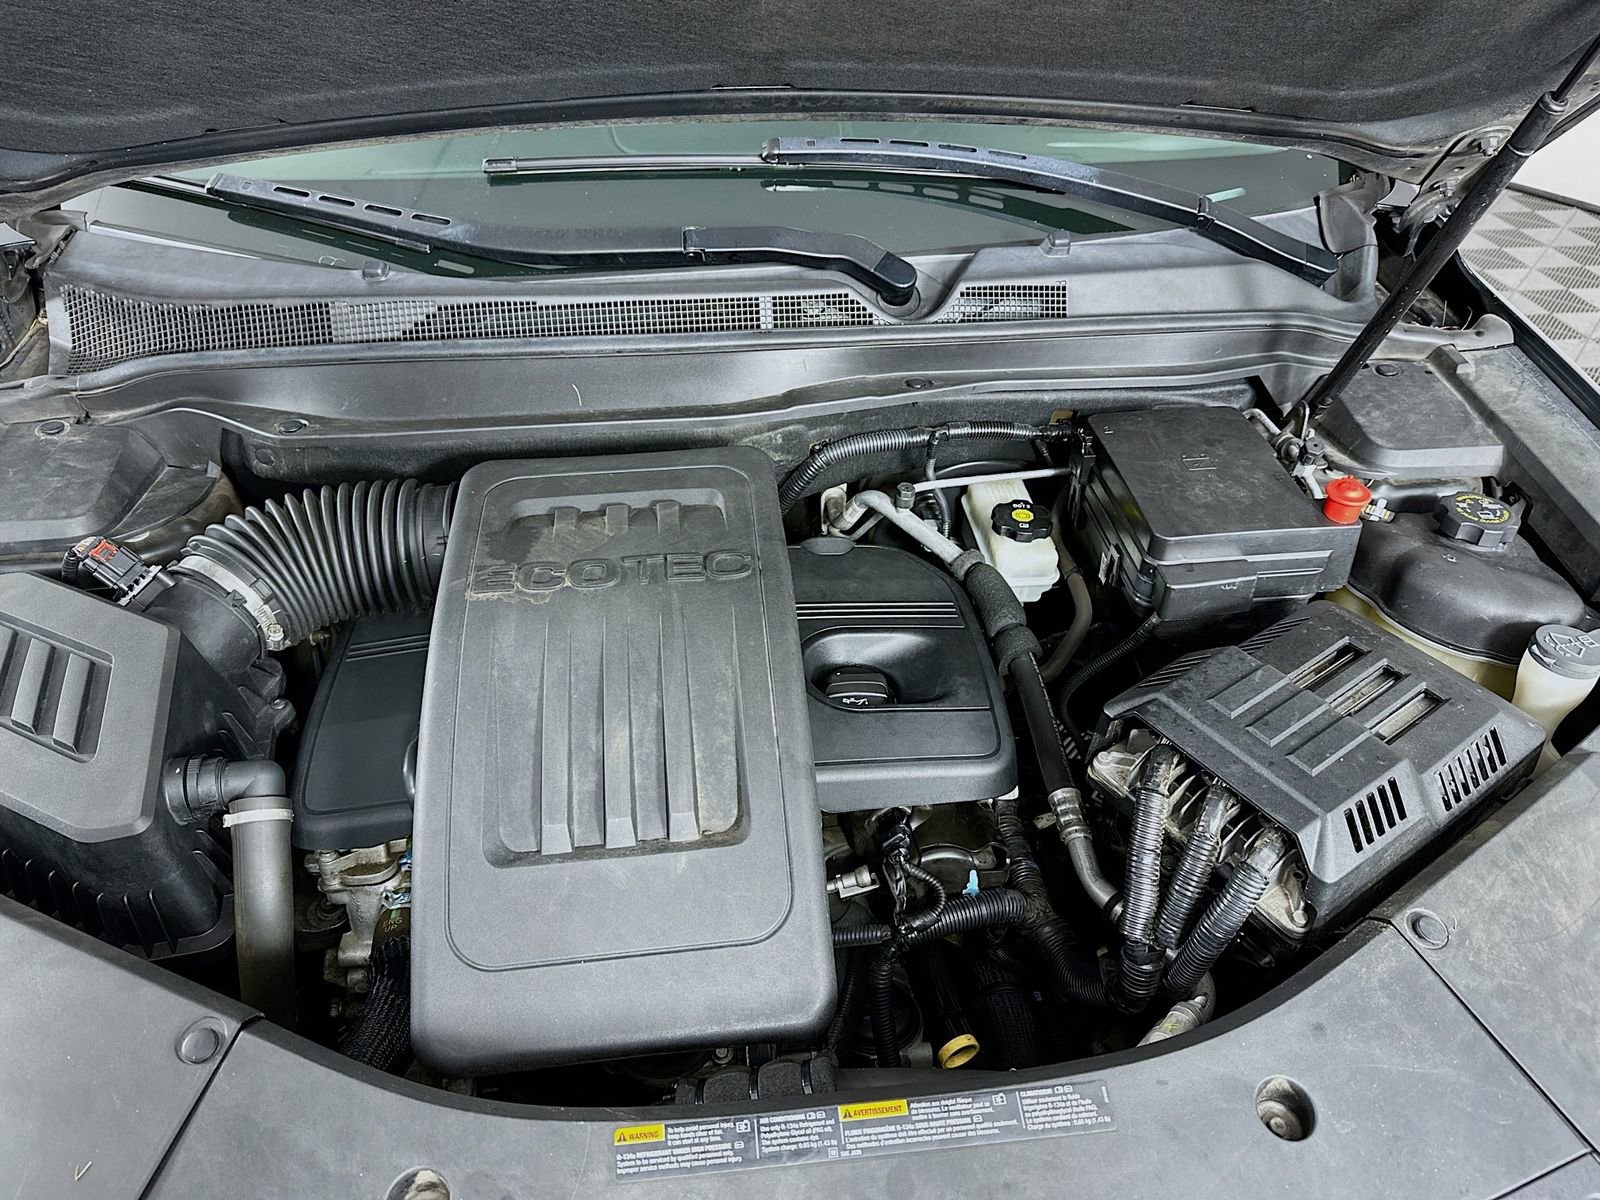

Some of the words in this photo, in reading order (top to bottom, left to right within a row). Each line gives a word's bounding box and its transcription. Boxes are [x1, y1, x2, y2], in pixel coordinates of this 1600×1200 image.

[472, 550, 752, 594] ECOTEC
[383, 918, 402, 928] ENG
[384, 924, 398, 932] UP
[854, 1106, 902, 1116] AVERTISSEMENT
[628, 1131, 659, 1140] WARNING
